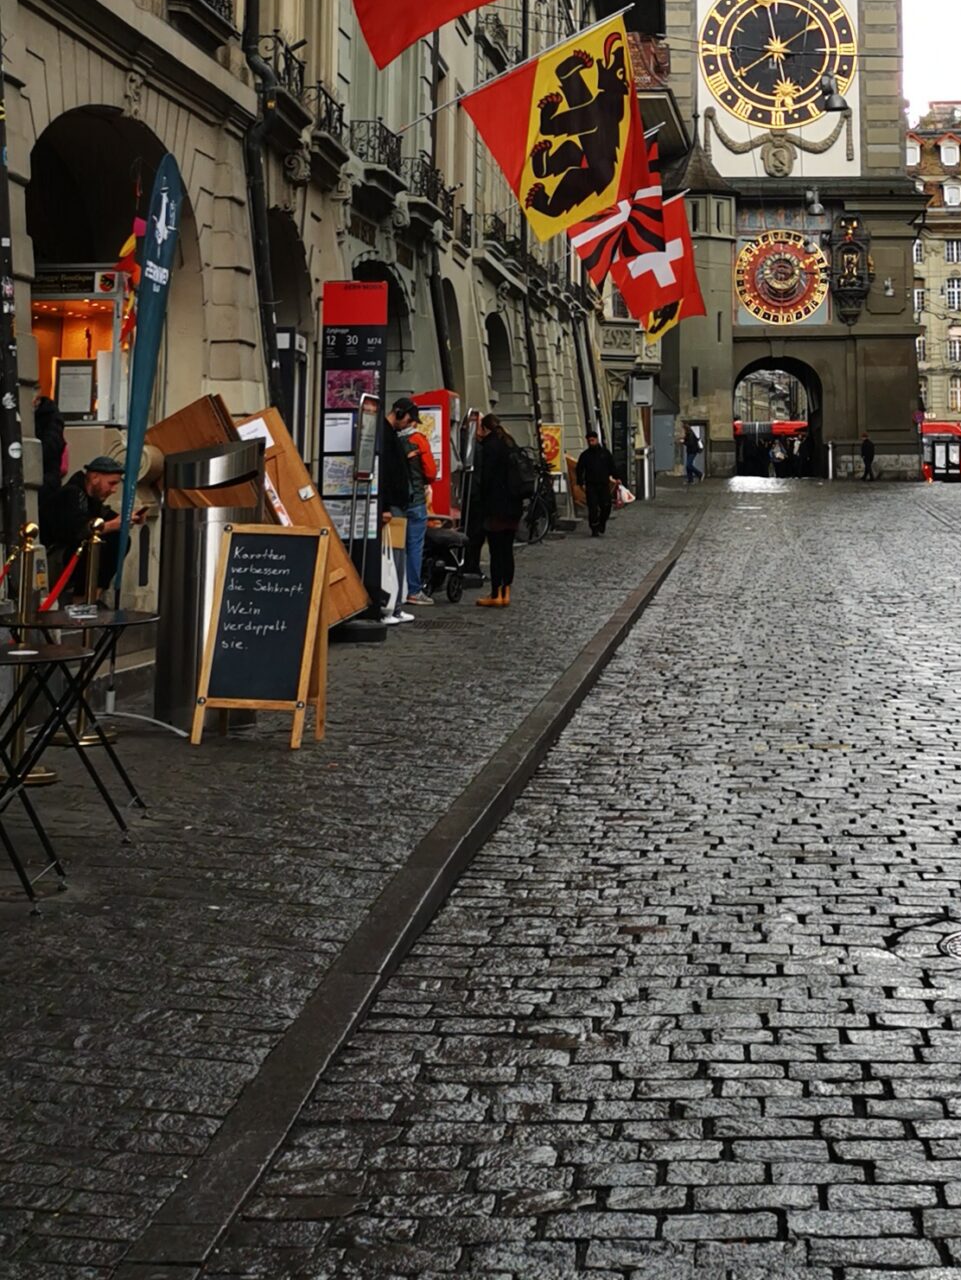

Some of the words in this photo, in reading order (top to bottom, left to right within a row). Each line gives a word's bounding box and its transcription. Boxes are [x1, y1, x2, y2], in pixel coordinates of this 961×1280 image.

[326, 335, 337, 346] 12
[346, 334, 359, 346] 30
[367, 337, 382, 345] M74
[233, 546, 287, 561] Karotten
[227, 578, 245, 591] die
[226, 600, 261, 615] Wein
[223, 620, 287, 636] verdoppelt
[221, 636, 249, 650] sie.
